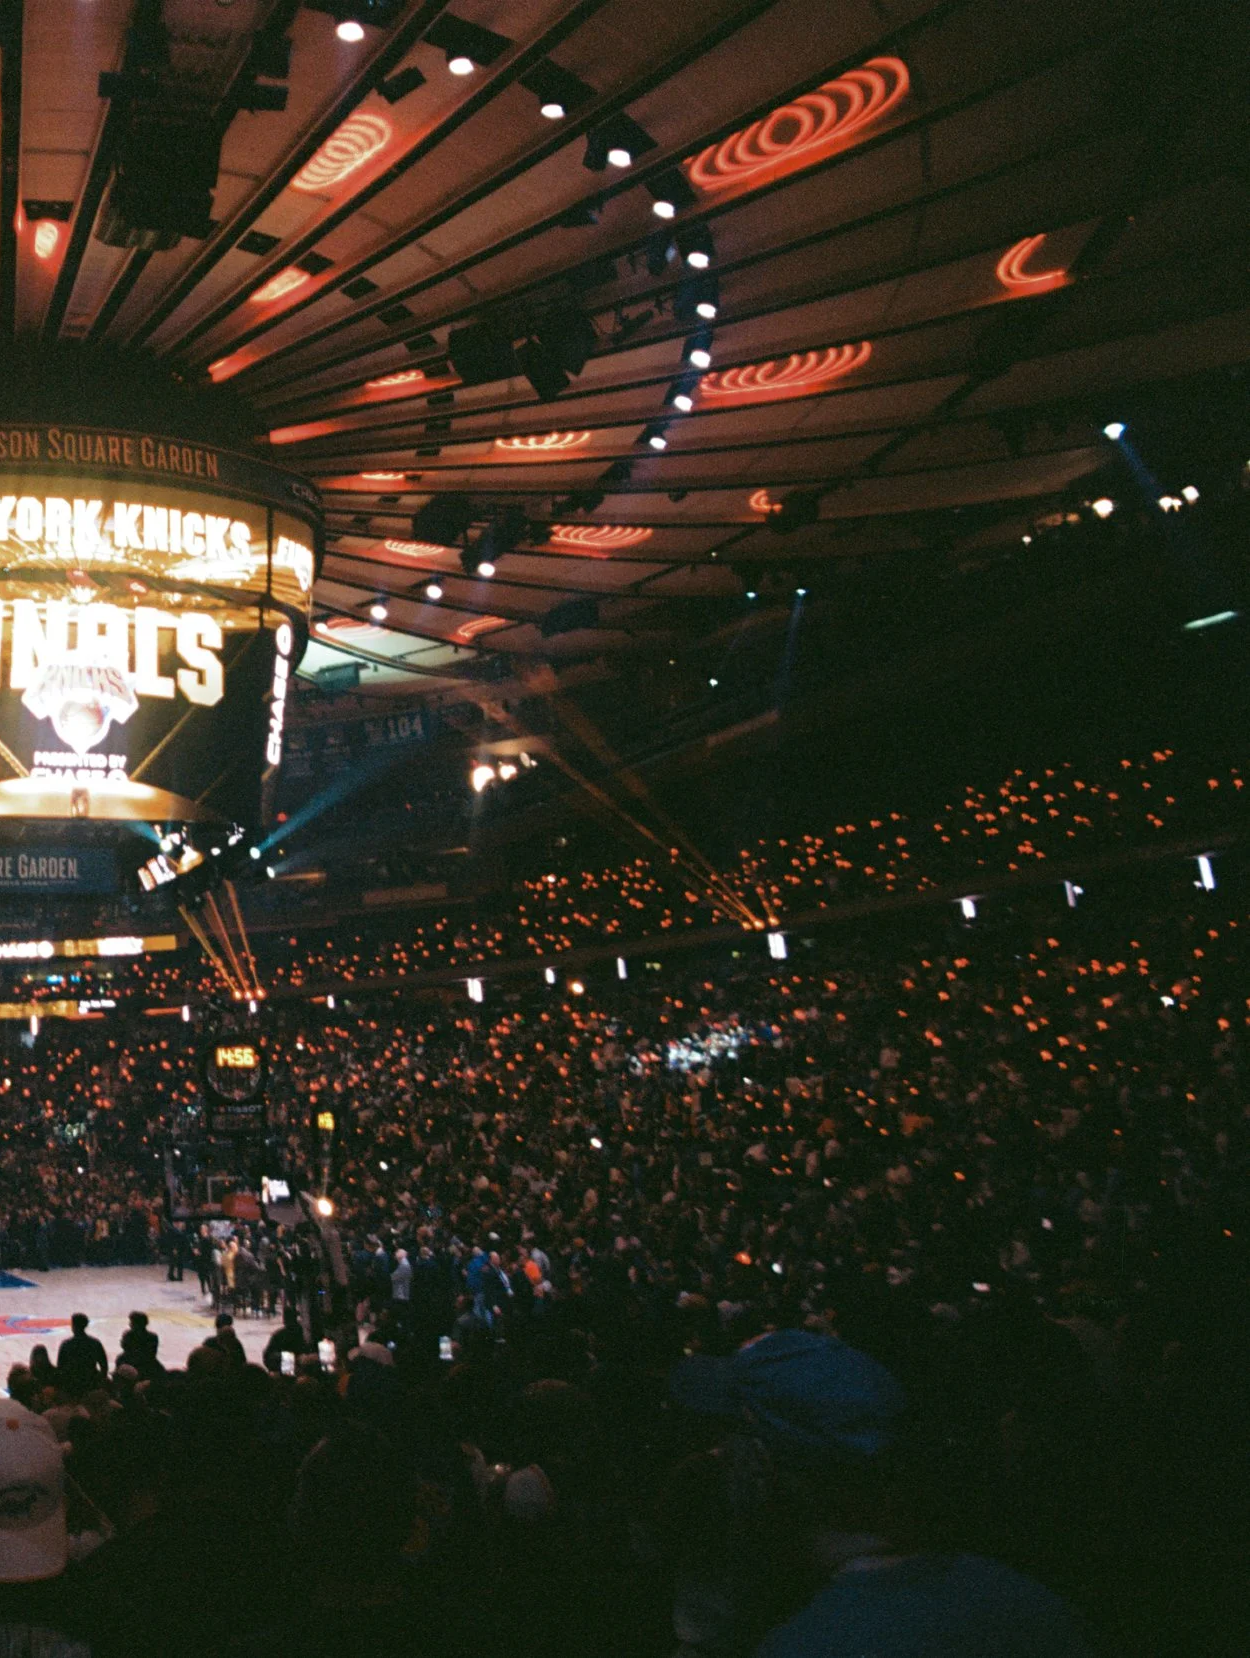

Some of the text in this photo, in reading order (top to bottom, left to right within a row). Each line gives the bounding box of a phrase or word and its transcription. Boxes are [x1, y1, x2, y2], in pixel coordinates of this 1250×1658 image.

[47, 427, 133, 466] SQUARE
[140, 437, 219, 479] GARDEN
[114, 502, 251, 560] KNICKS
[266, 654, 290, 766] CHASE
[108, 754, 127, 769] BY
[17, 853, 78, 880] GARDEN
